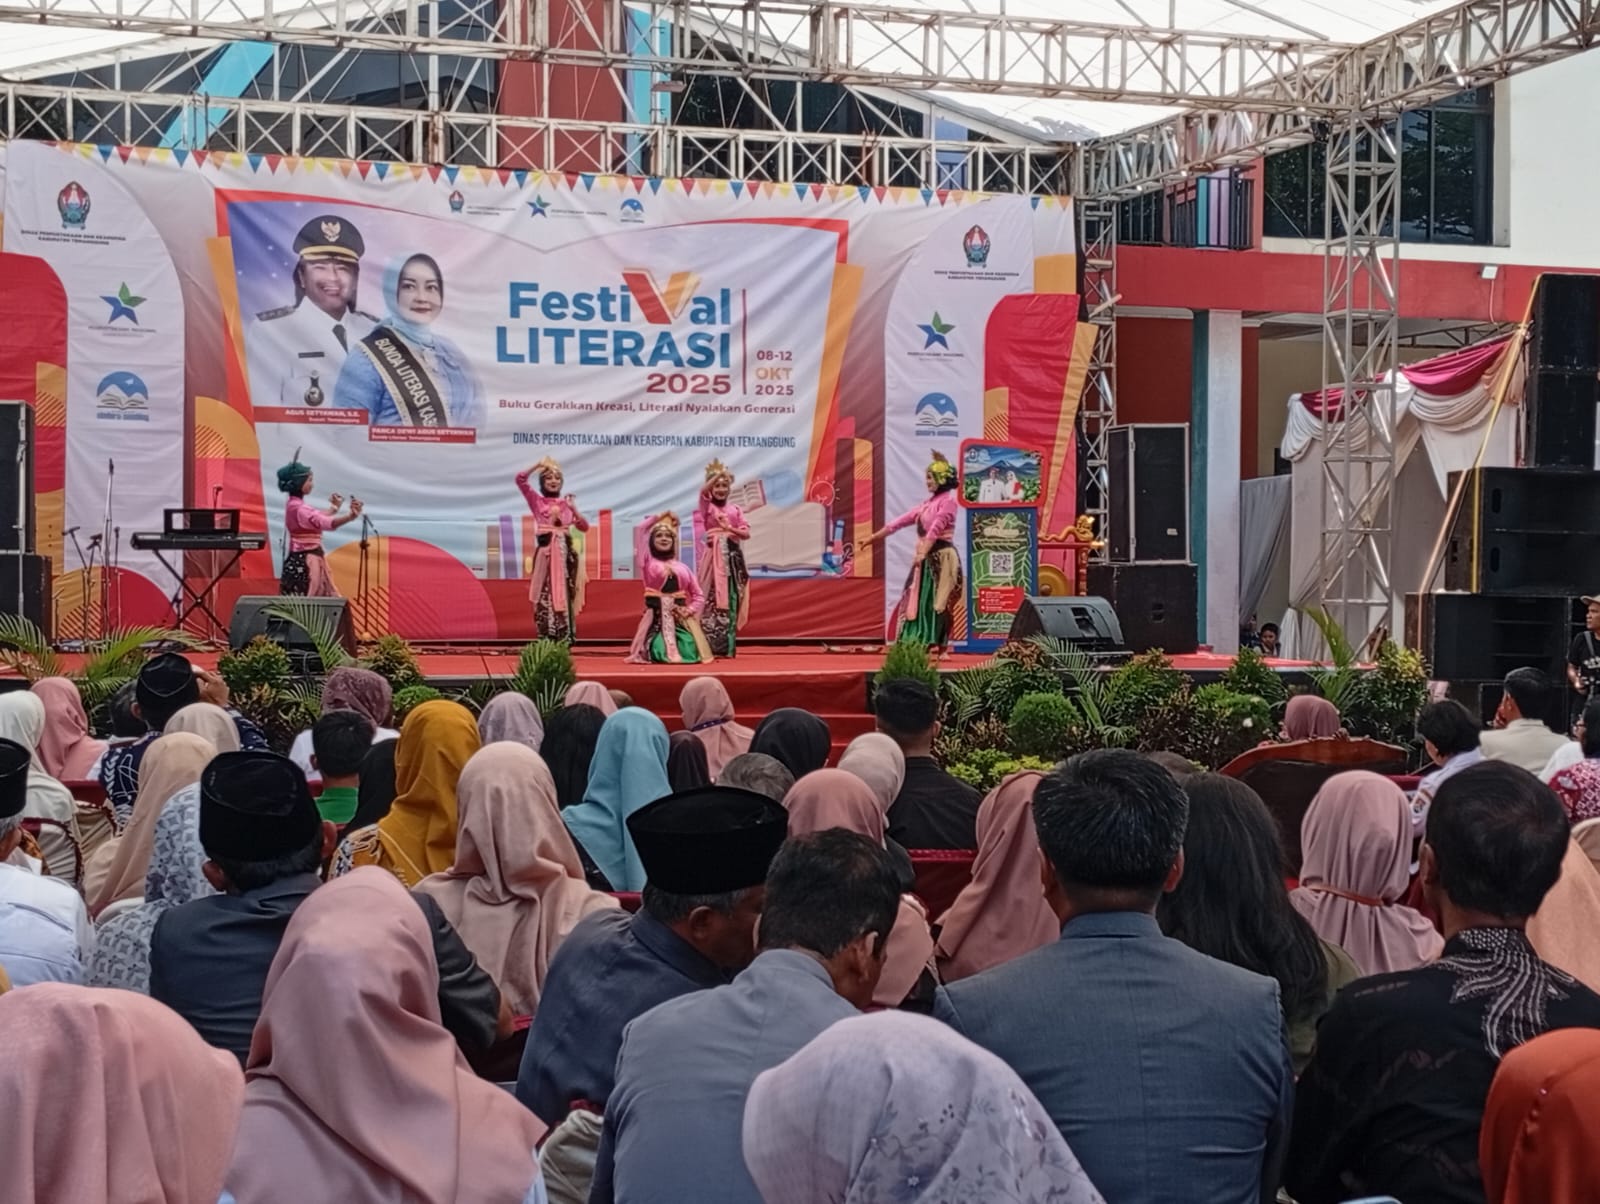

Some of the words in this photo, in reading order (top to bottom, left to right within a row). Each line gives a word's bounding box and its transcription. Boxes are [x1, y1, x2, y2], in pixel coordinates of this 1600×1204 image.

[496, 326, 731, 368] LITERASI
[756, 350, 793, 361] 08-12
[374, 338, 406, 368] BUNDA
[396, 364, 431, 408] LITERASI
[755, 367, 793, 380] OKT
[646, 373, 732, 395] 2025
[755, 384, 795, 396] 2025
[498, 400, 531, 409] Buku
[534, 400, 593, 411] Gerakkan
[595, 401, 637, 413] Kreasi,
[639, 402, 683, 412] Literasi
[685, 403, 741, 415] Nyalakan
[744, 404, 796, 414] Generasi
[513, 432, 540, 445] DINAS
[542, 432, 612, 446] PERPUSTAKAAN
[614, 434, 632, 446] DAN
[634, 434, 683, 447] KEARSIPAN
[684, 435, 735, 448] KABUPATEN
[737, 436, 796, 448] TEMANGGUNG
